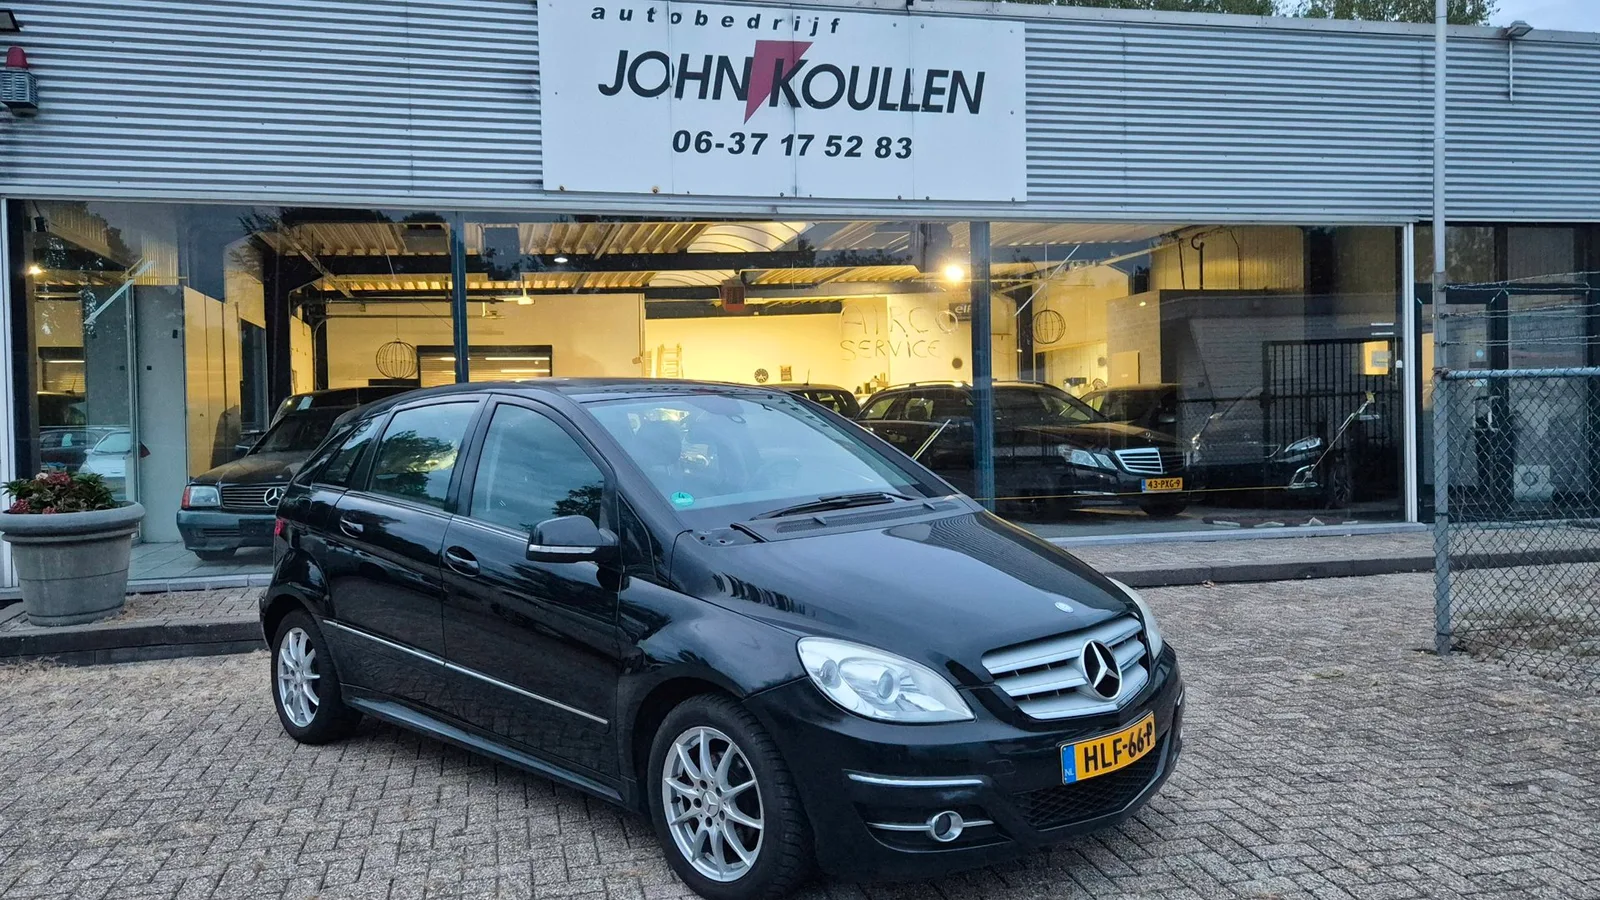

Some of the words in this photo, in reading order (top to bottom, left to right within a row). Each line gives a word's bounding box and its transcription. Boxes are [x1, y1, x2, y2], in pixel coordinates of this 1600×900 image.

[591, 7, 840, 36] autobedrijf
[598, 50, 754, 101] JOHN
[769, 58, 985, 114] KOULLEN
[672, 130, 768, 156] 06-37
[781, 134, 815, 156] 17
[824, 135, 863, 158] 52
[874, 137, 912, 159] 83
[840, 304, 959, 335] AIRCO
[1147, 479, 1181, 489] 43-PXG-9
[1084, 722, 1153, 773] HLF-66-P
[1064, 768, 1075, 777] NL
